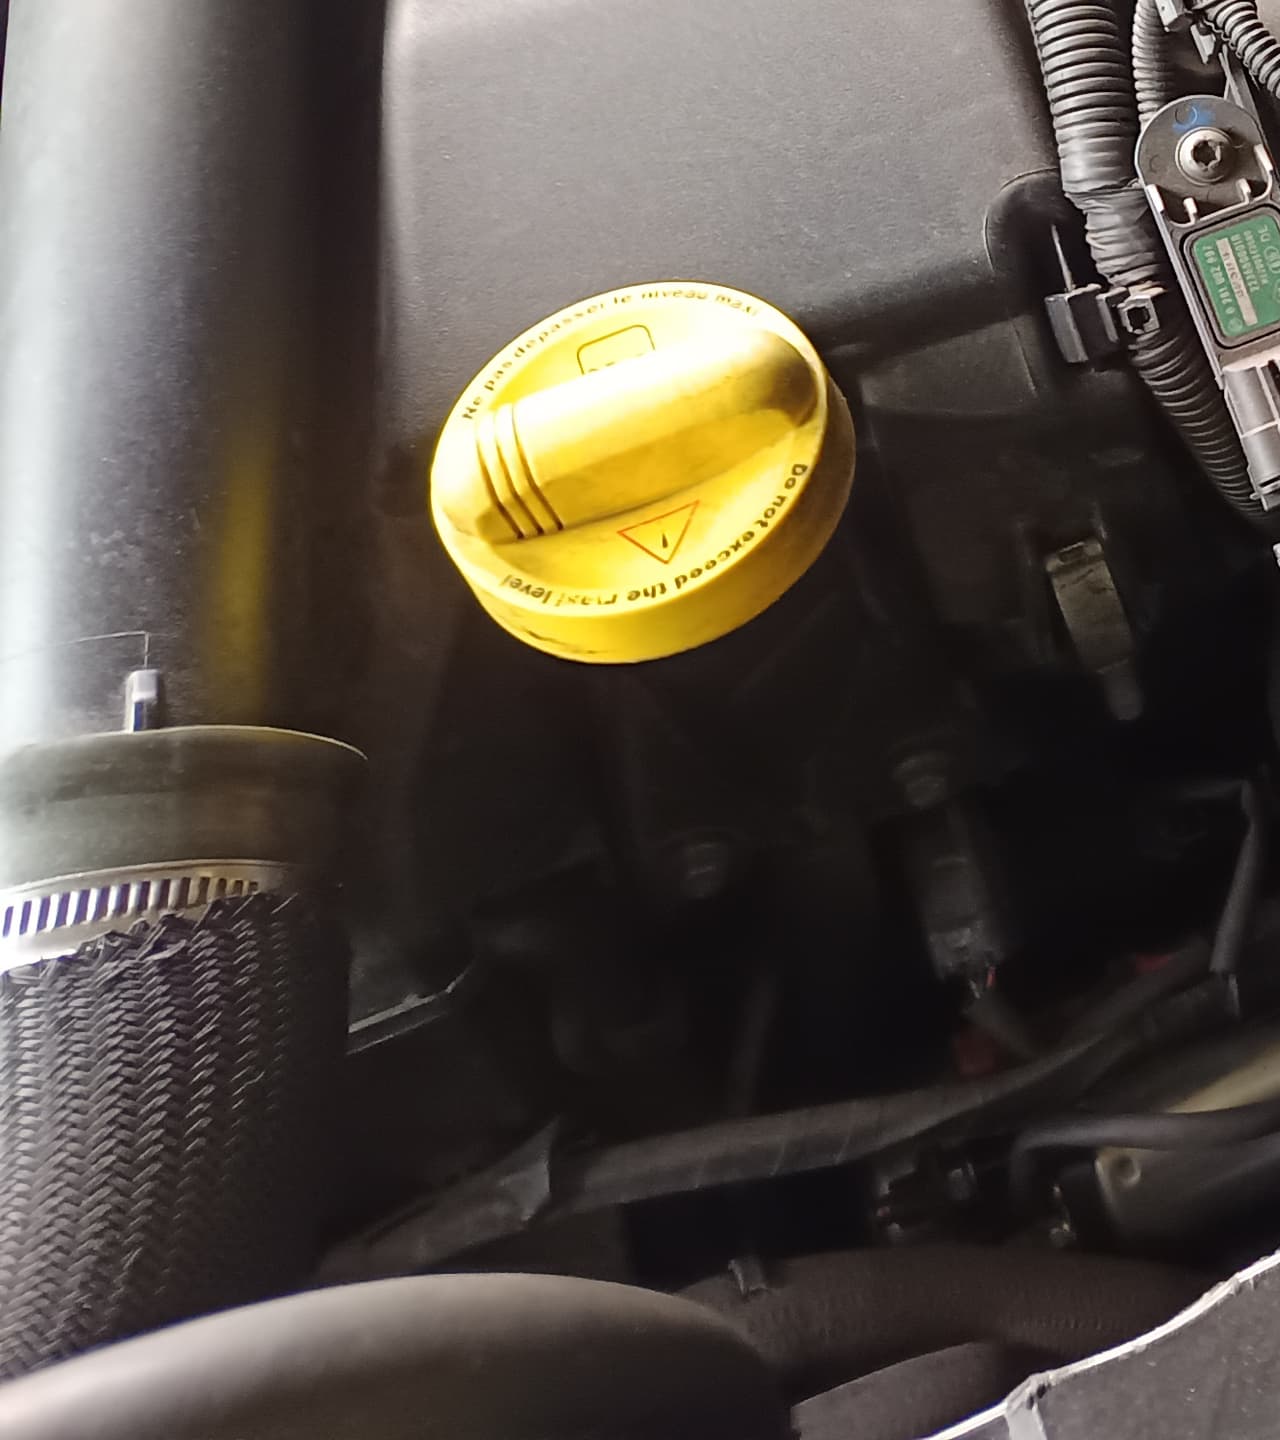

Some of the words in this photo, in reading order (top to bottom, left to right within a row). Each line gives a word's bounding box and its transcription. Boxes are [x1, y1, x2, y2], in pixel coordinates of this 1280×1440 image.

[462, 396, 482, 420] Ne
[483, 360, 513, 390] pas
[641, 289, 708, 301] niveau
[785, 463, 809, 491] Do
[755, 495, 786, 530] not
[674, 530, 755, 591] exceed
[499, 574, 553, 604] level
[626, 582, 668, 603] the
